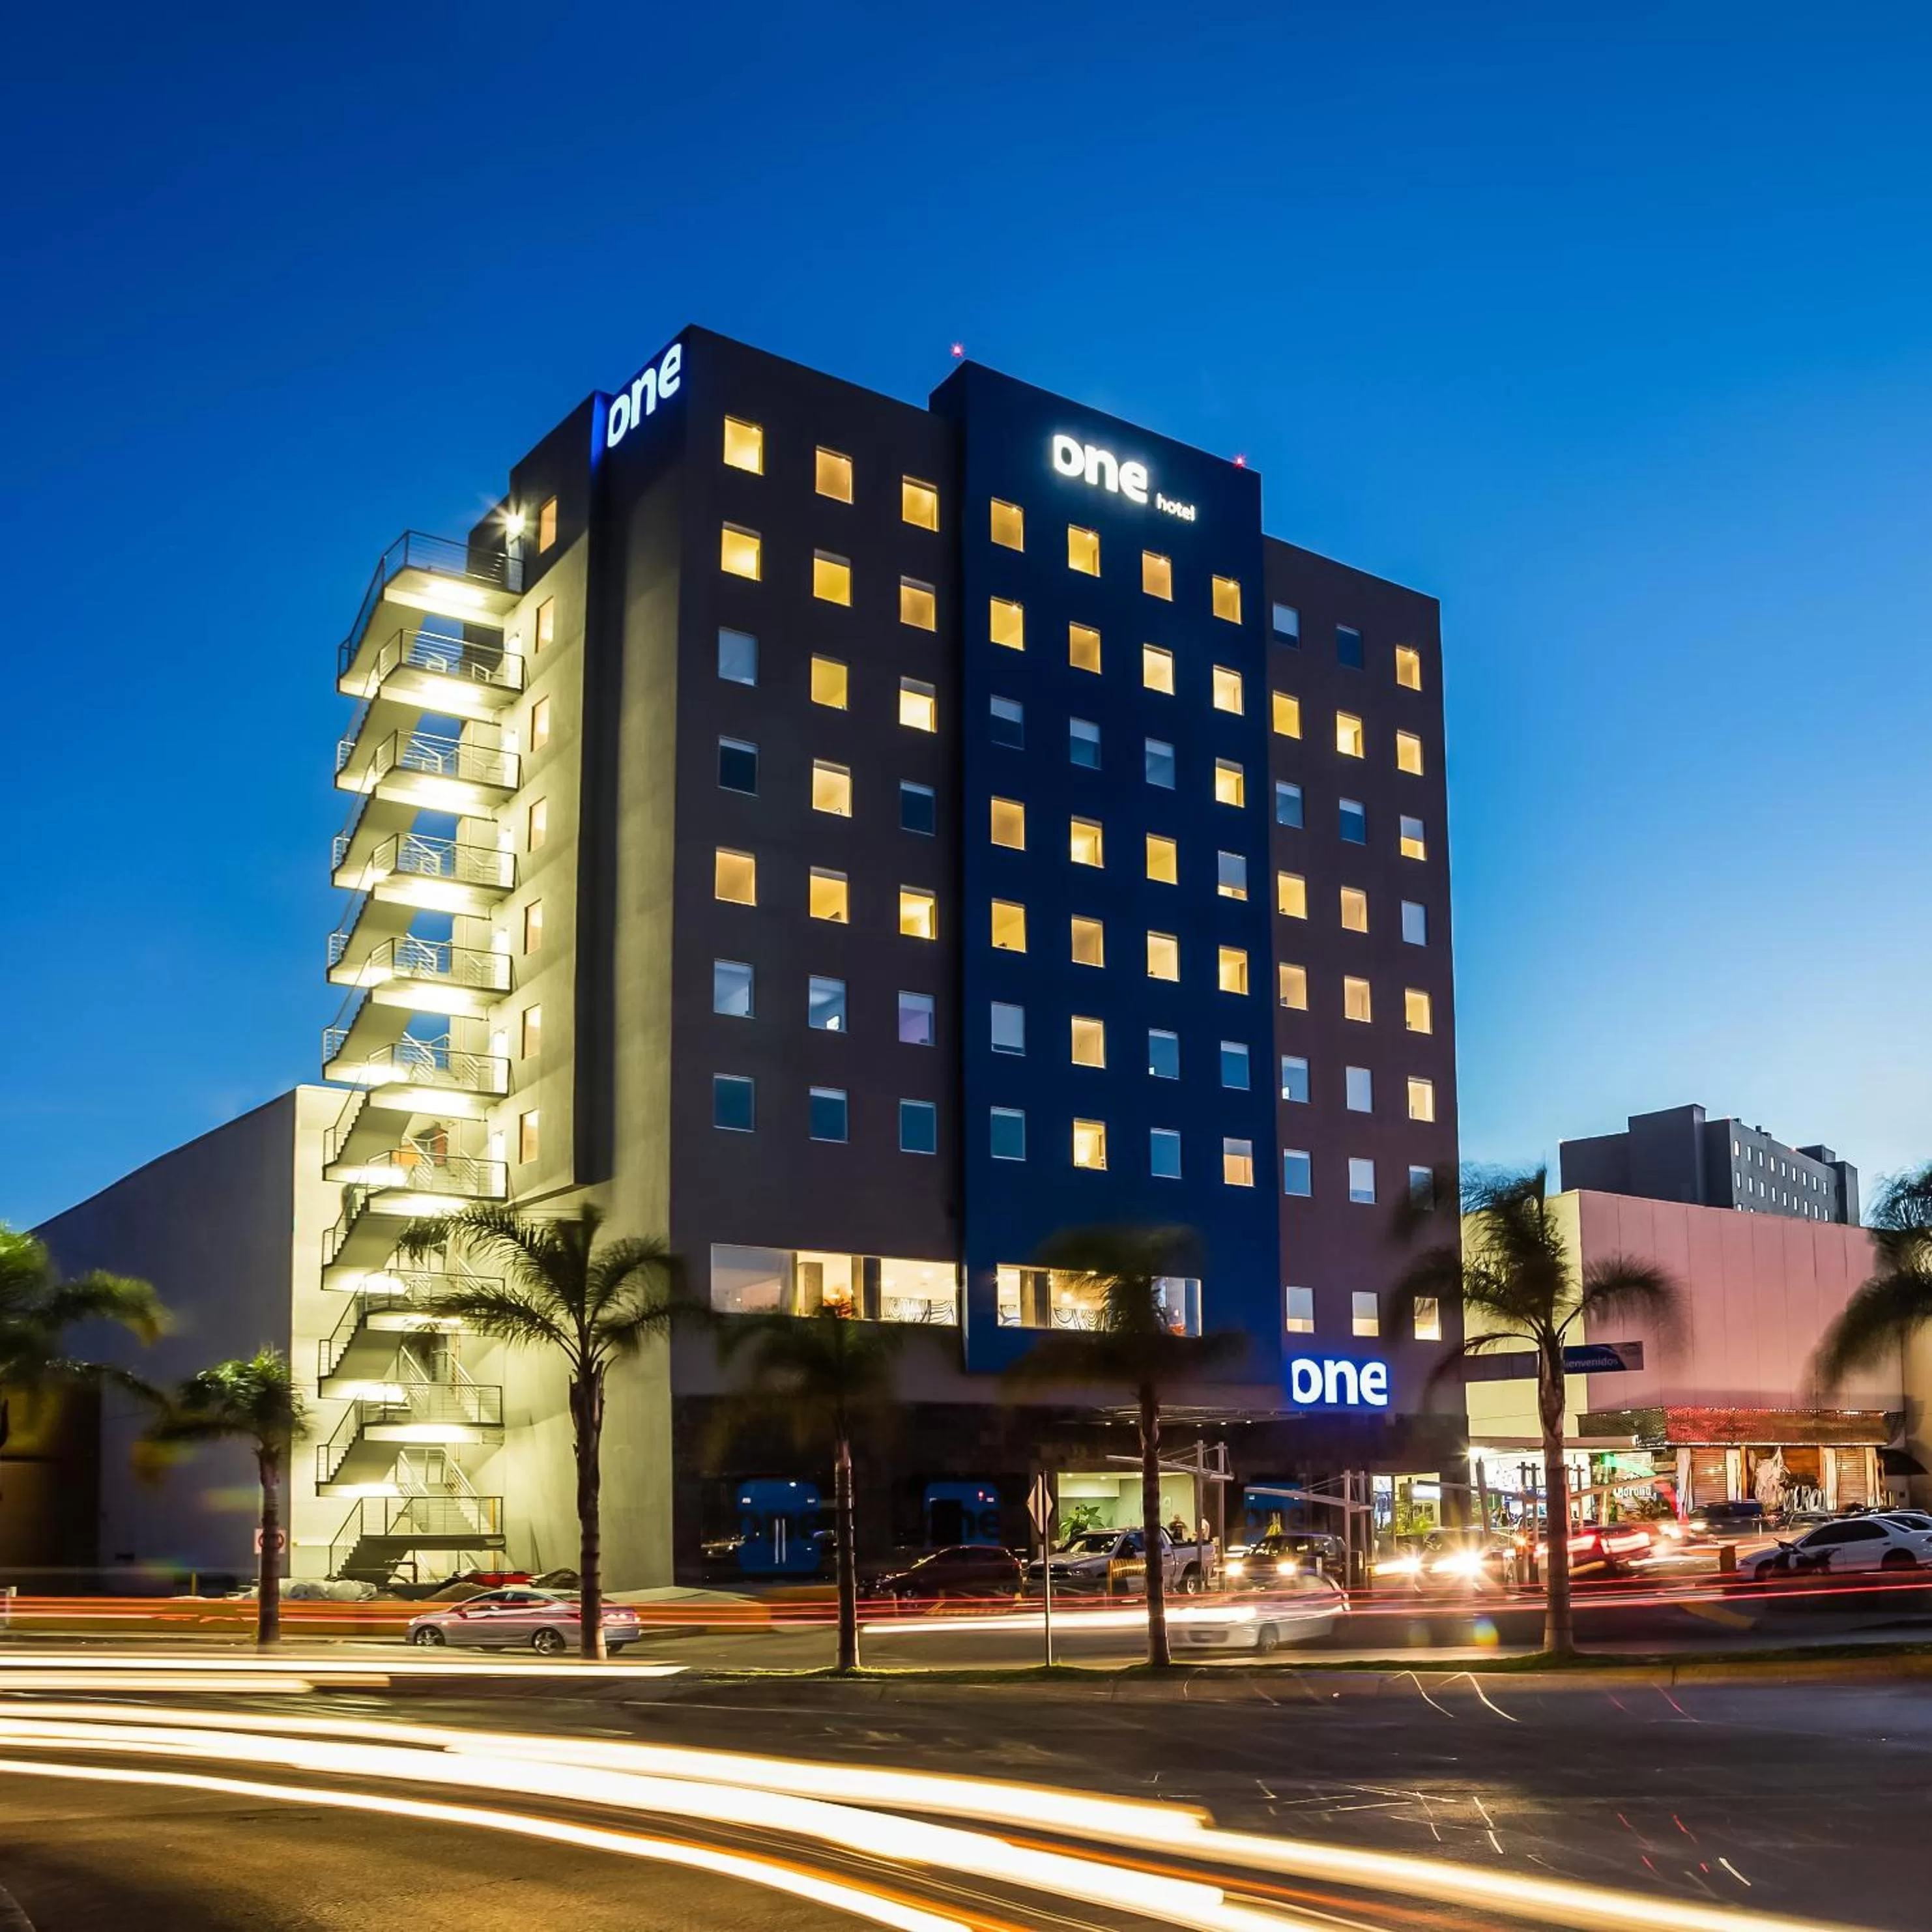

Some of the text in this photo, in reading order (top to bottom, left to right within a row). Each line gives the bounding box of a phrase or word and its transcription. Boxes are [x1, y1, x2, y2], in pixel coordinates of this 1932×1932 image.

[607, 343, 682, 448] one
[1052, 434, 1148, 504] one
[1157, 492, 1196, 521] hotel
[1291, 1359, 1388, 1406] one
[1563, 1355, 1619, 1368] ienvenidos
